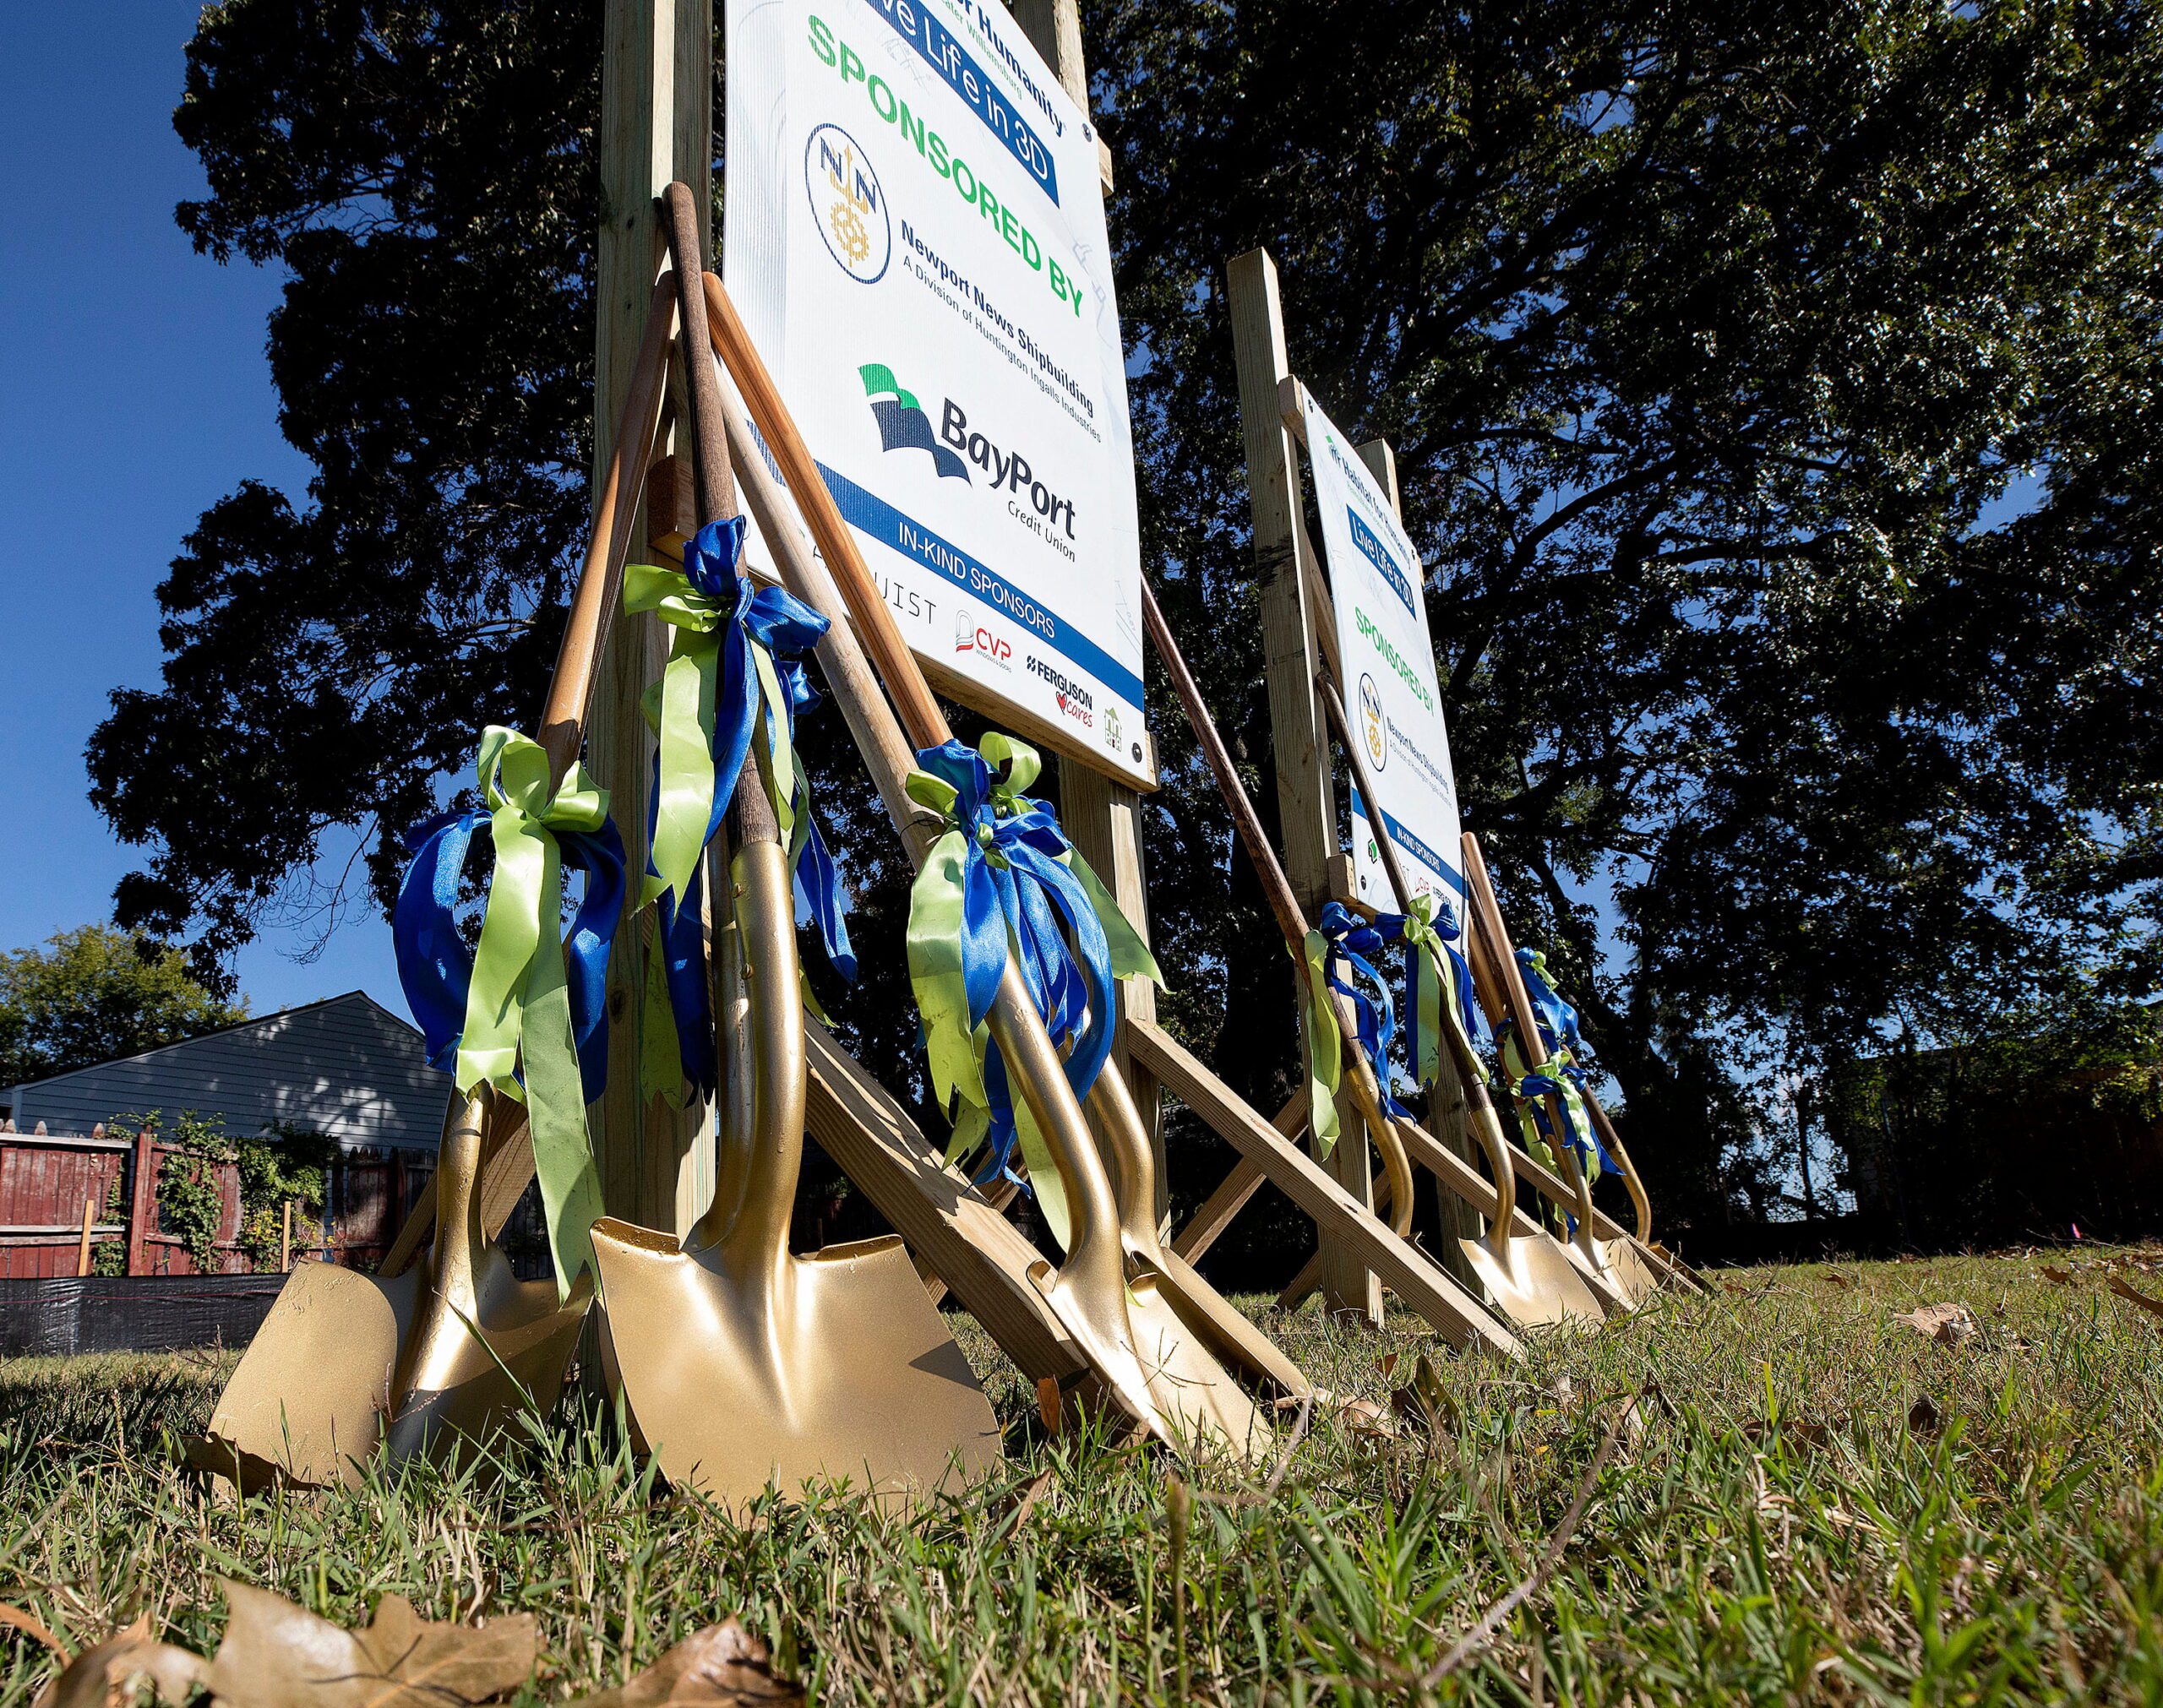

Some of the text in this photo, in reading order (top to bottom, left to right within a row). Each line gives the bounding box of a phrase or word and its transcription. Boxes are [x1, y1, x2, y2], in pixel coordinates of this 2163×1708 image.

[924, 16, 980, 104] Life
[985, 84, 1009, 139] in
[1015, 121, 1048, 180] 3D
[941, 0, 1022, 101] ater Williamsburg
[977, 5, 1062, 138] Humanity
[808, 14, 1082, 318] SPONSORED BY
[902, 219, 1093, 418] Newport News Shipbuilding
[903, 255, 1101, 443] A Division of Huntington Ingalls Industries
[941, 397, 1076, 541] BayPort
[899, 522, 1056, 639] IN-KIND SPONSORS
[1008, 500, 1076, 563] Credit Union
[1353, 516, 1376, 558] Live
[1375, 542, 1394, 583] Life
[977, 628, 1011, 661] CVP
[1038, 661, 1092, 710] FERGUSON
[1355, 607, 1422, 700] SPONSORED
[1423, 686, 1434, 716] BY
[1066, 700, 1092, 727] cares
[1398, 826, 1440, 871] IN-KIND SPONSORS
